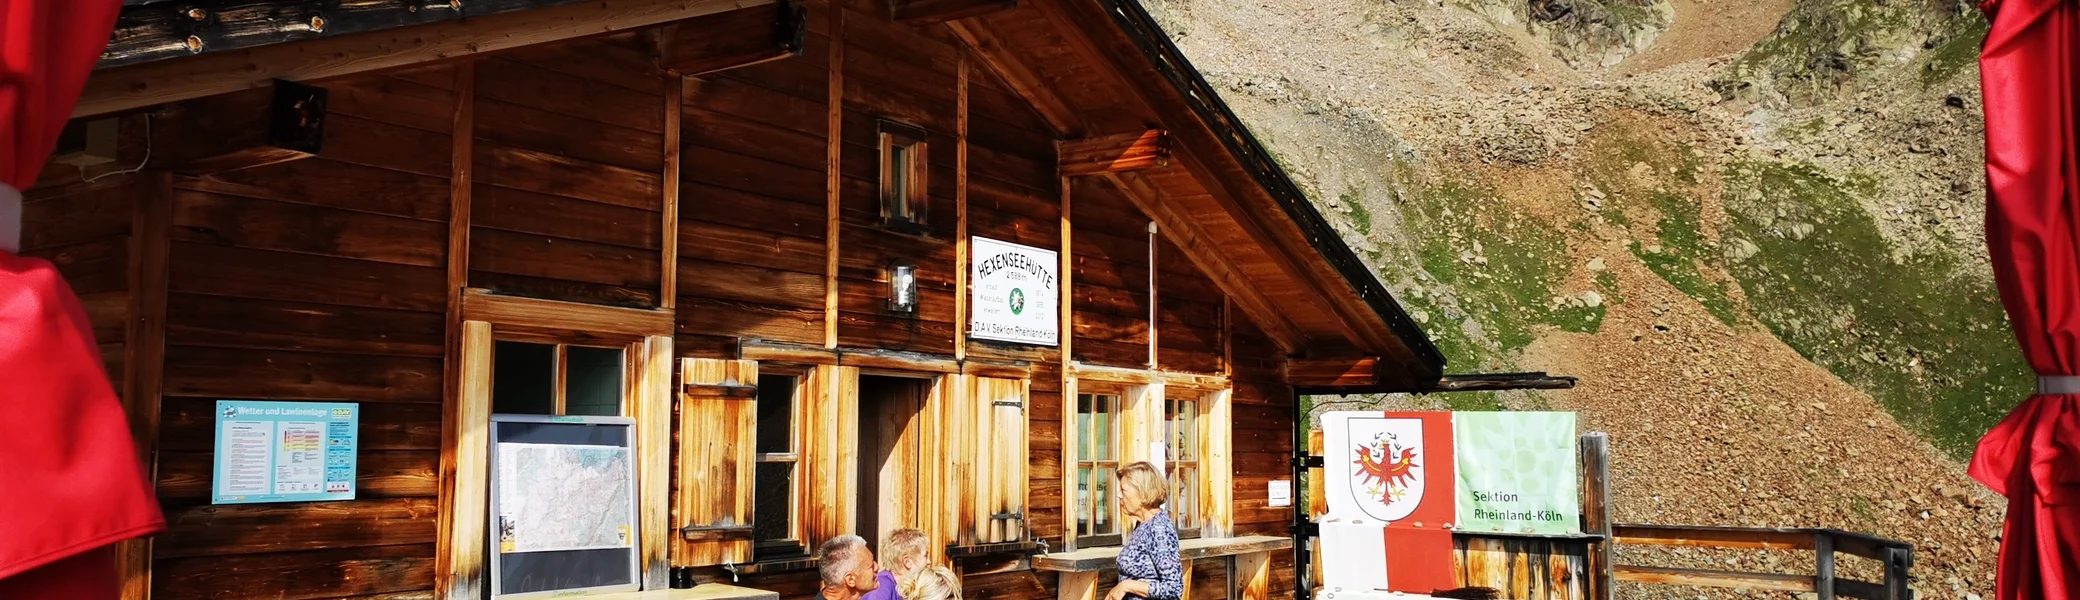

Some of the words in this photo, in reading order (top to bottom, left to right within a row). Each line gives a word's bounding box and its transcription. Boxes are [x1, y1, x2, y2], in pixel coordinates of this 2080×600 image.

[977, 252, 1053, 290] HEXENSEEHÜTTE
[992, 323, 1014, 335] Sektion
[237, 406, 264, 415] Wetter
[265, 407, 280, 415] und
[281, 407, 328, 417] Lawinenlage
[1472, 490, 1518, 502] Sektion
[1474, 508, 1563, 521] Rheinland-Köln
